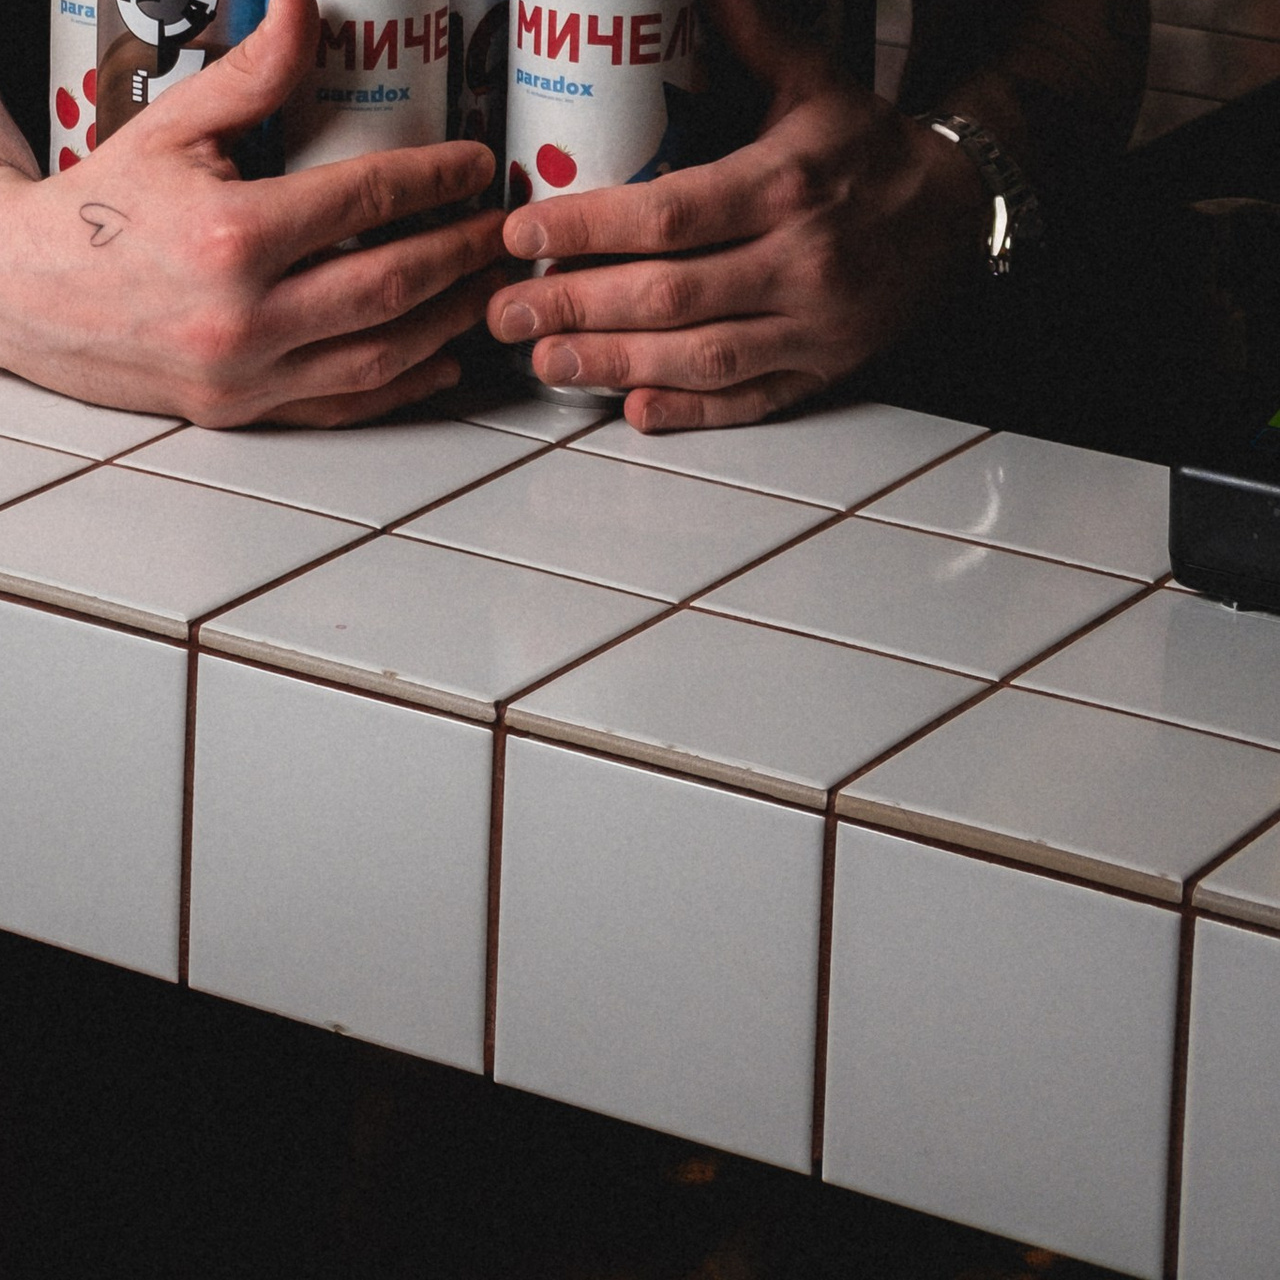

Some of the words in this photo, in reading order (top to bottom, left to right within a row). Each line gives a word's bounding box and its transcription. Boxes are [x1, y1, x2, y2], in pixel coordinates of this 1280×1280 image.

[517, 0, 697, 66] МИЧЕЛ
[317, 84, 411, 103] paradox
[516, 68, 594, 98] paradox
